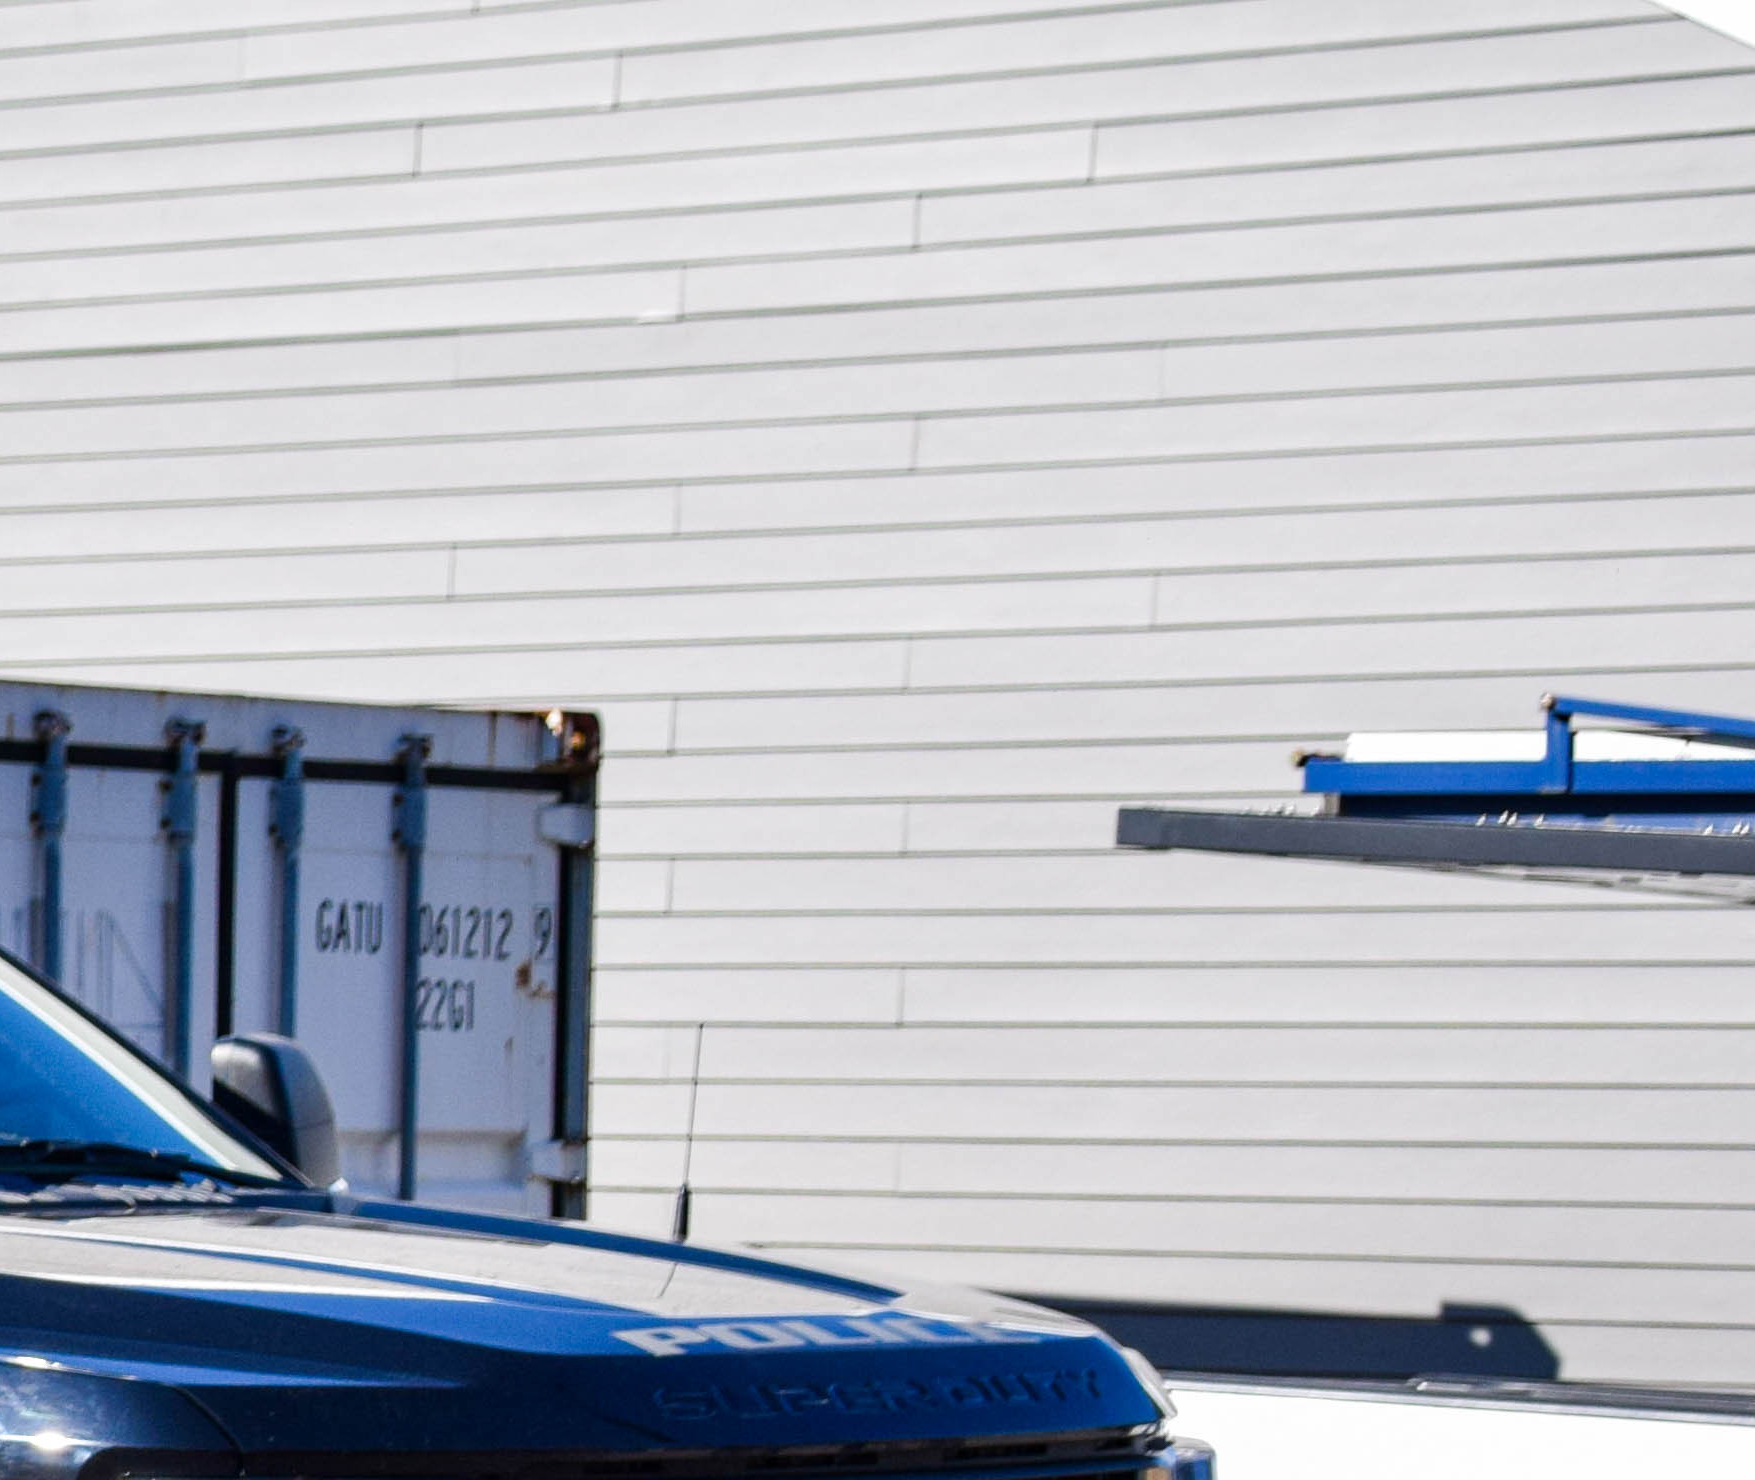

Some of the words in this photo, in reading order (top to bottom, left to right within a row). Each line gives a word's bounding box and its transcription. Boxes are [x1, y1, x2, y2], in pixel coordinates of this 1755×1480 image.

[314, 897, 384, 953] GATU
[418, 903, 513, 961] 061212
[534, 906, 553, 959] 9
[415, 976, 475, 1033] 22G1
